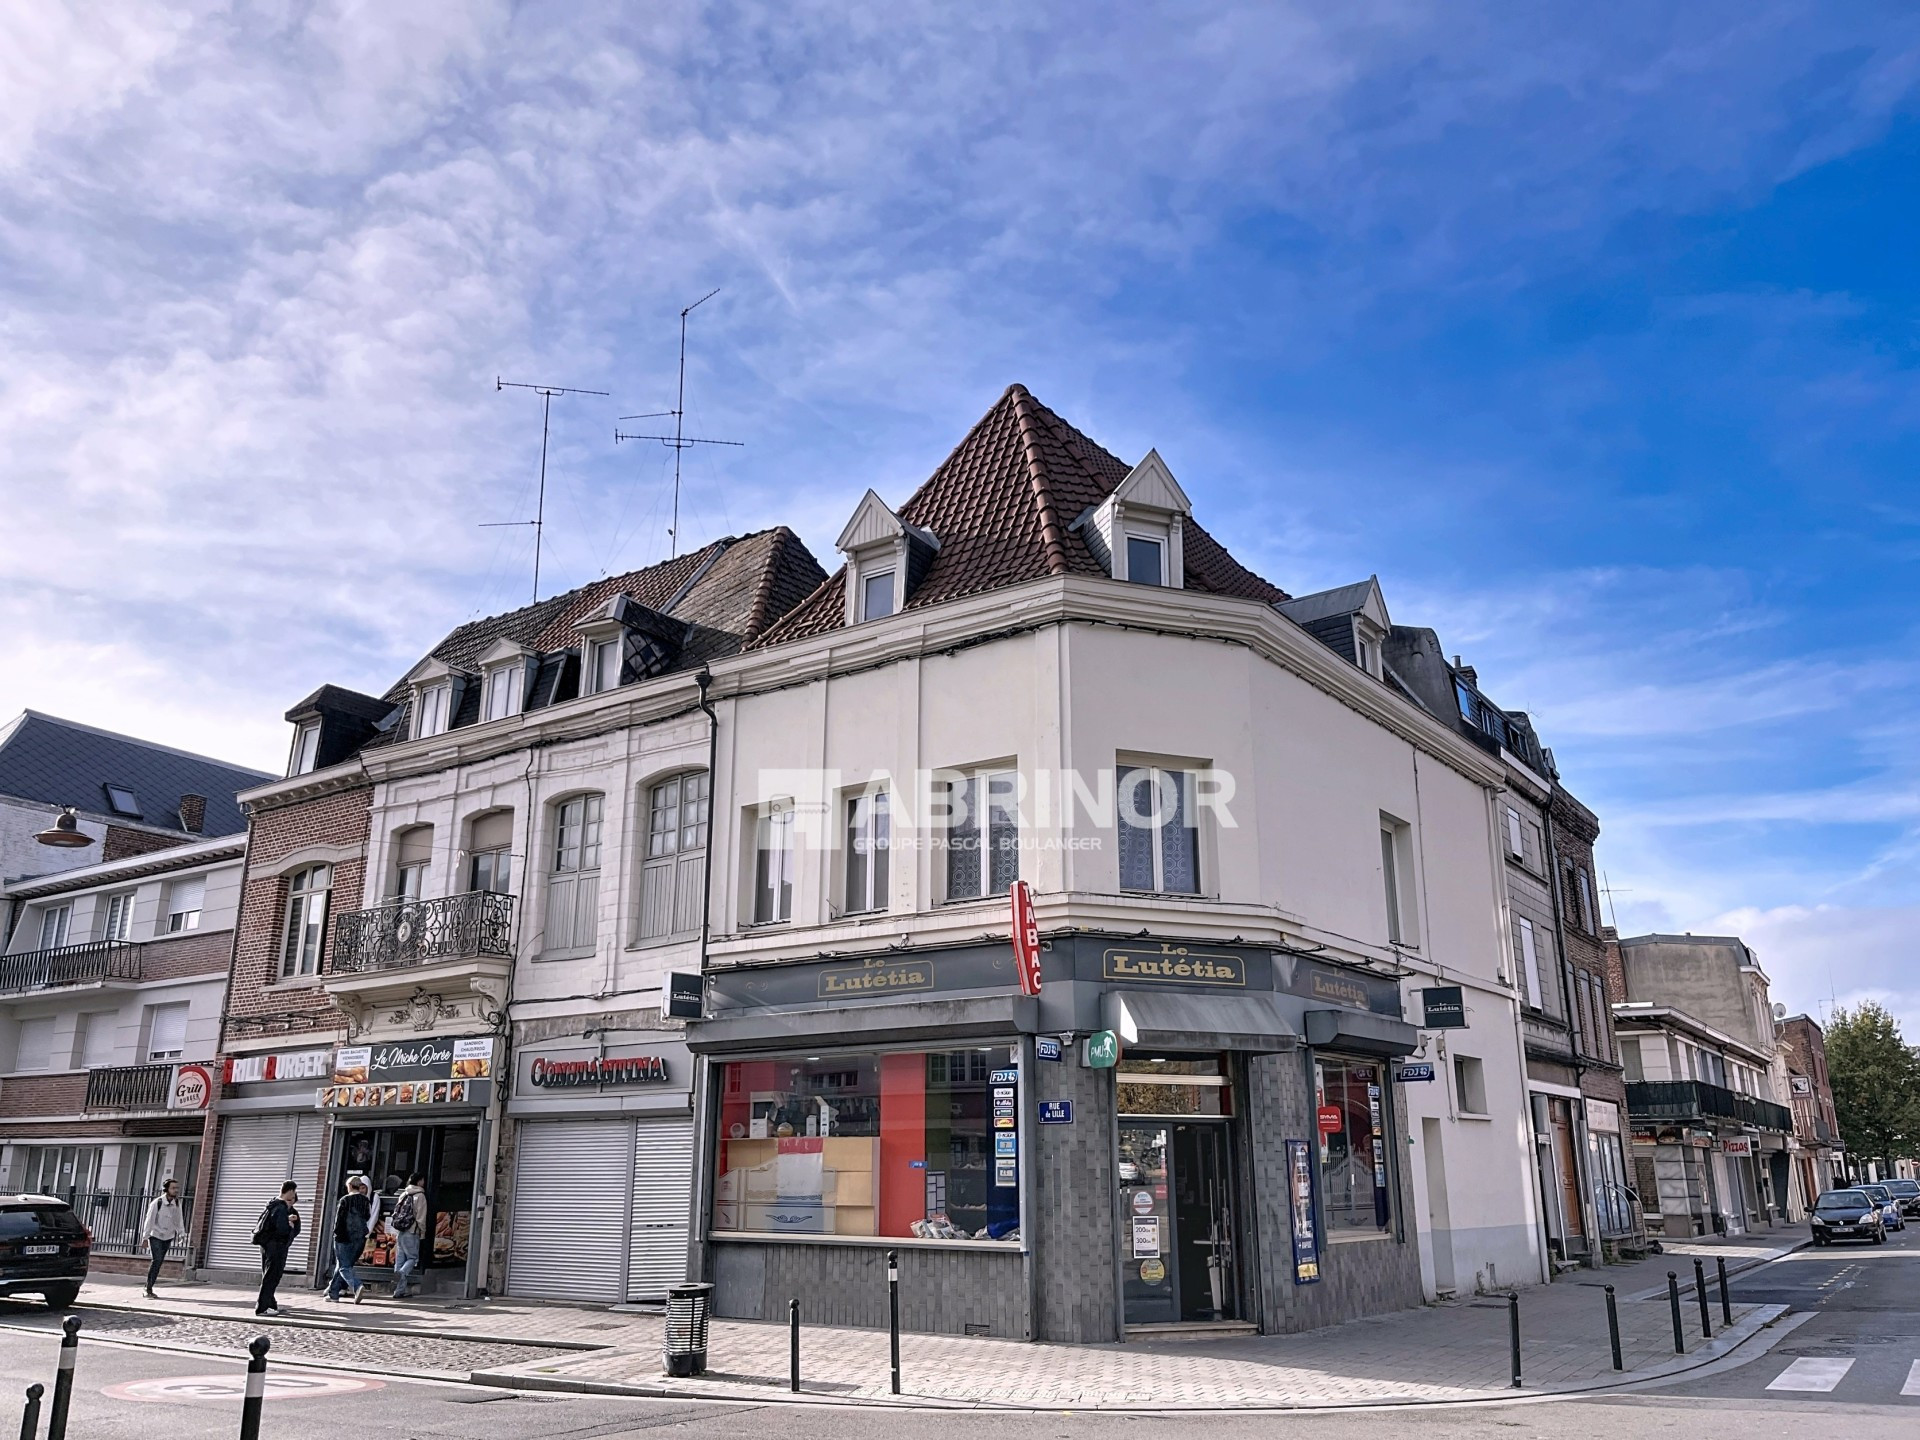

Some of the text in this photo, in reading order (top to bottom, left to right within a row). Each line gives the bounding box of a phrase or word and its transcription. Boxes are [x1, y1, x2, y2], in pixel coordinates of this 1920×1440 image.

[1023, 885, 1042, 990] TABAC
[1161, 944, 1188, 955] Le
[863, 959, 886, 968] Le
[1113, 955, 1236, 979] Lutétia
[1333, 968, 1345, 978] Le
[825, 969, 926, 992] Lutétia
[1314, 976, 1366, 1002] Lutétia
[673, 992, 700, 1002] Lutétia
[1040, 1044, 1051, 1055] FDJ
[1090, 1045, 1104, 1058] PMU
[370, 1044, 453, 1070] La Miche Dorée
[223, 1052, 327, 1084] GRILL BURGER
[1403, 1068, 1419, 1077] FDJ
[992, 1073, 1007, 1081] FDJ
[176, 1084, 203, 1097] Grill
[179, 1094, 200, 1104] BURGER
[1049, 1102, 1060, 1110] RUE
[1045, 1110, 1051, 1118] de
[1722, 1139, 1749, 1153] Pizzas
